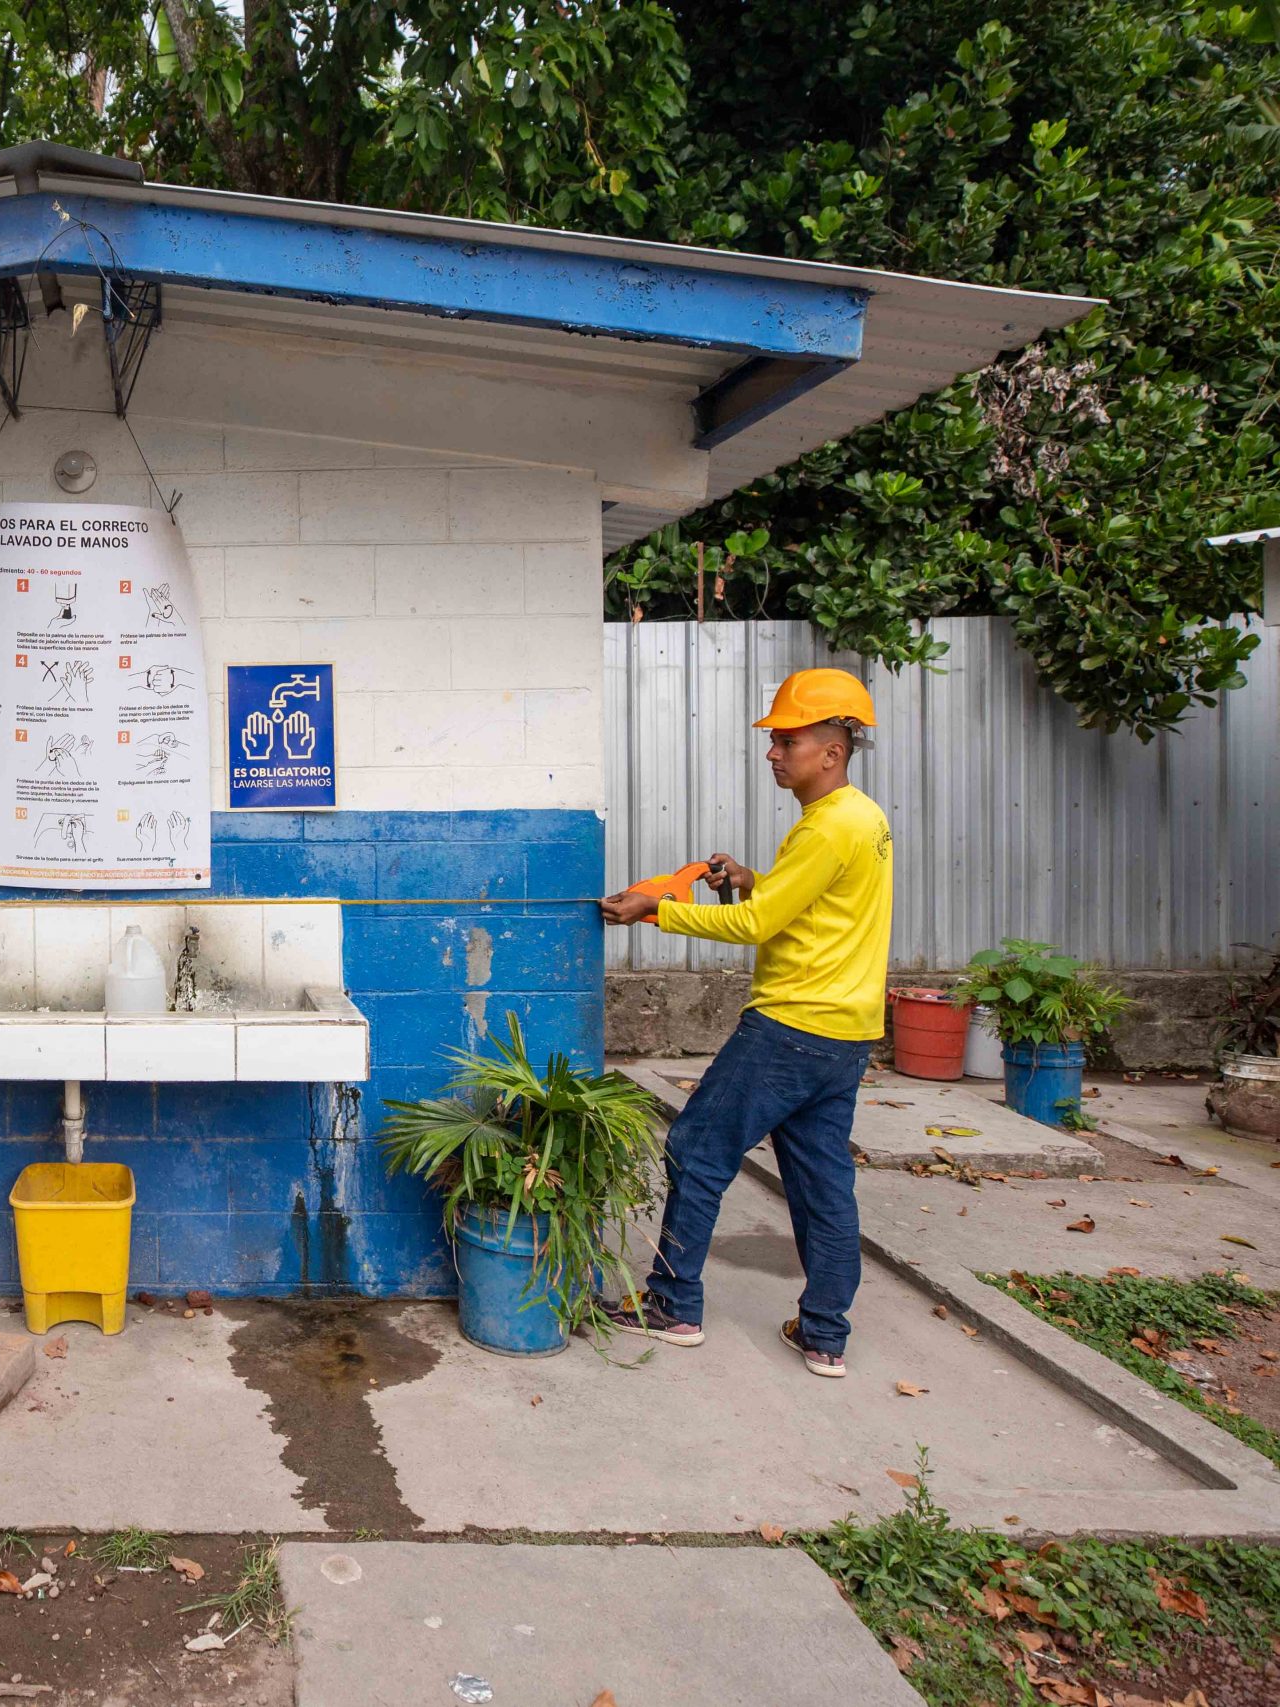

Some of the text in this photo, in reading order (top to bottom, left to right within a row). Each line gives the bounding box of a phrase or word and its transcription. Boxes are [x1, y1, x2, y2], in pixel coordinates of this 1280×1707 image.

[20, 519, 55, 531] PARA
[60, 520, 77, 531] EL
[82, 520, 148, 532] CORRECTO
[0, 535, 128, 548] LAVADO DE MANOS
[20, 581, 25, 590] 1
[122, 583, 128, 592] 2
[19, 657, 25, 666] 4
[122, 658, 128, 666] 5
[19, 732, 24, 740] 7
[121, 733, 127, 741] 8
[234, 767, 330, 777] ES OBLIGATORIO
[234, 778, 331, 788] LAVARSE LAS MANOS
